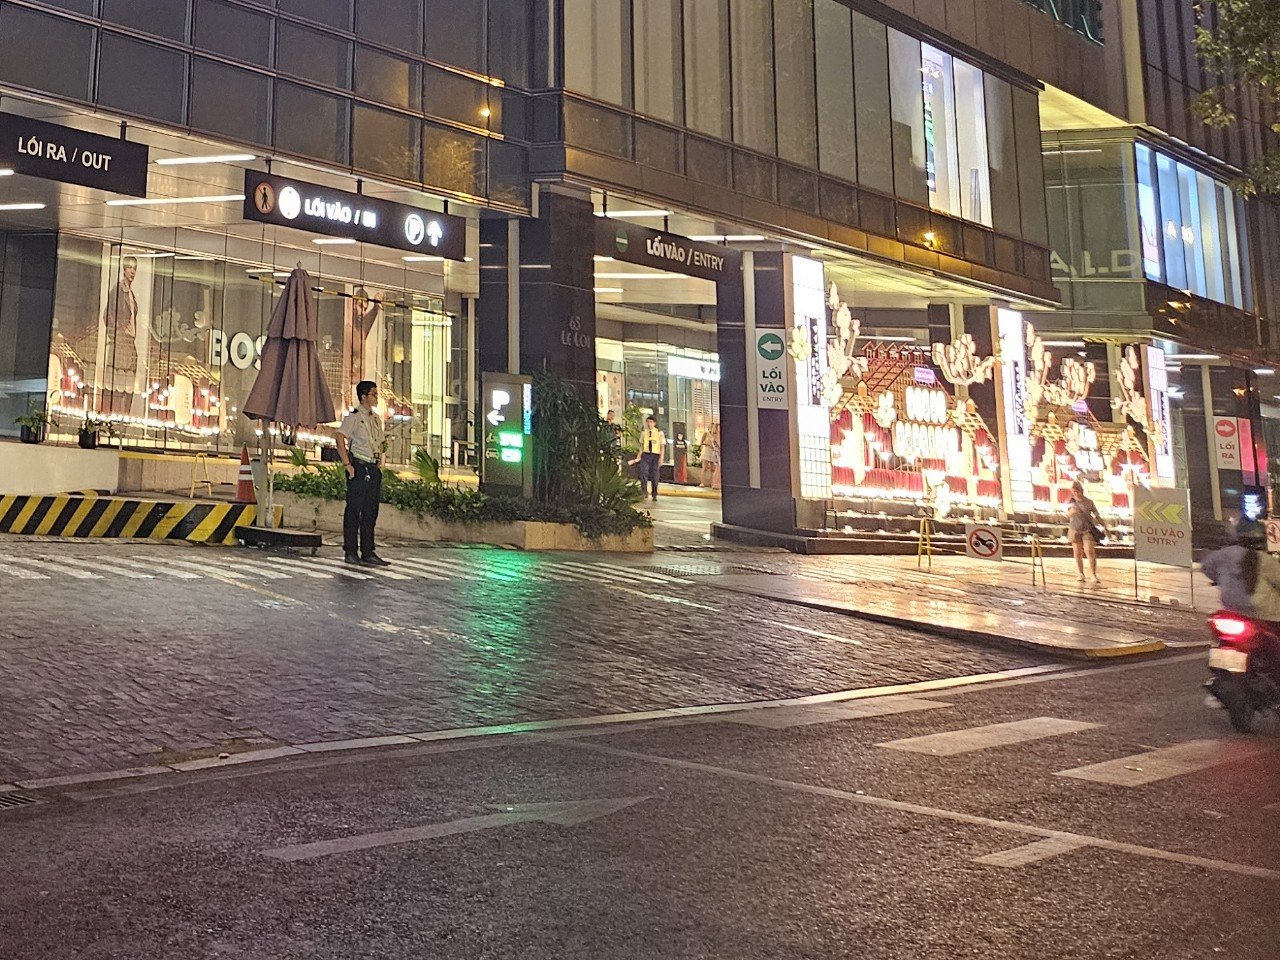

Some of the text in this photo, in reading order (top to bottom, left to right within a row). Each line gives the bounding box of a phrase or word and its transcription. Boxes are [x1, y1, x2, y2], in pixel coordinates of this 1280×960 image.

[45, 142, 68, 163] RA
[81, 150, 112, 171] OUT
[665, 243, 686, 263] VÀO
[693, 250, 725, 272] ENTRY
[762, 366, 782, 380] LỐI
[759, 381, 785, 394] VÀO
[492, 389, 511, 411] P
[1221, 452, 1235, 460] RA
[1147, 536, 1178, 546] ENTRY
